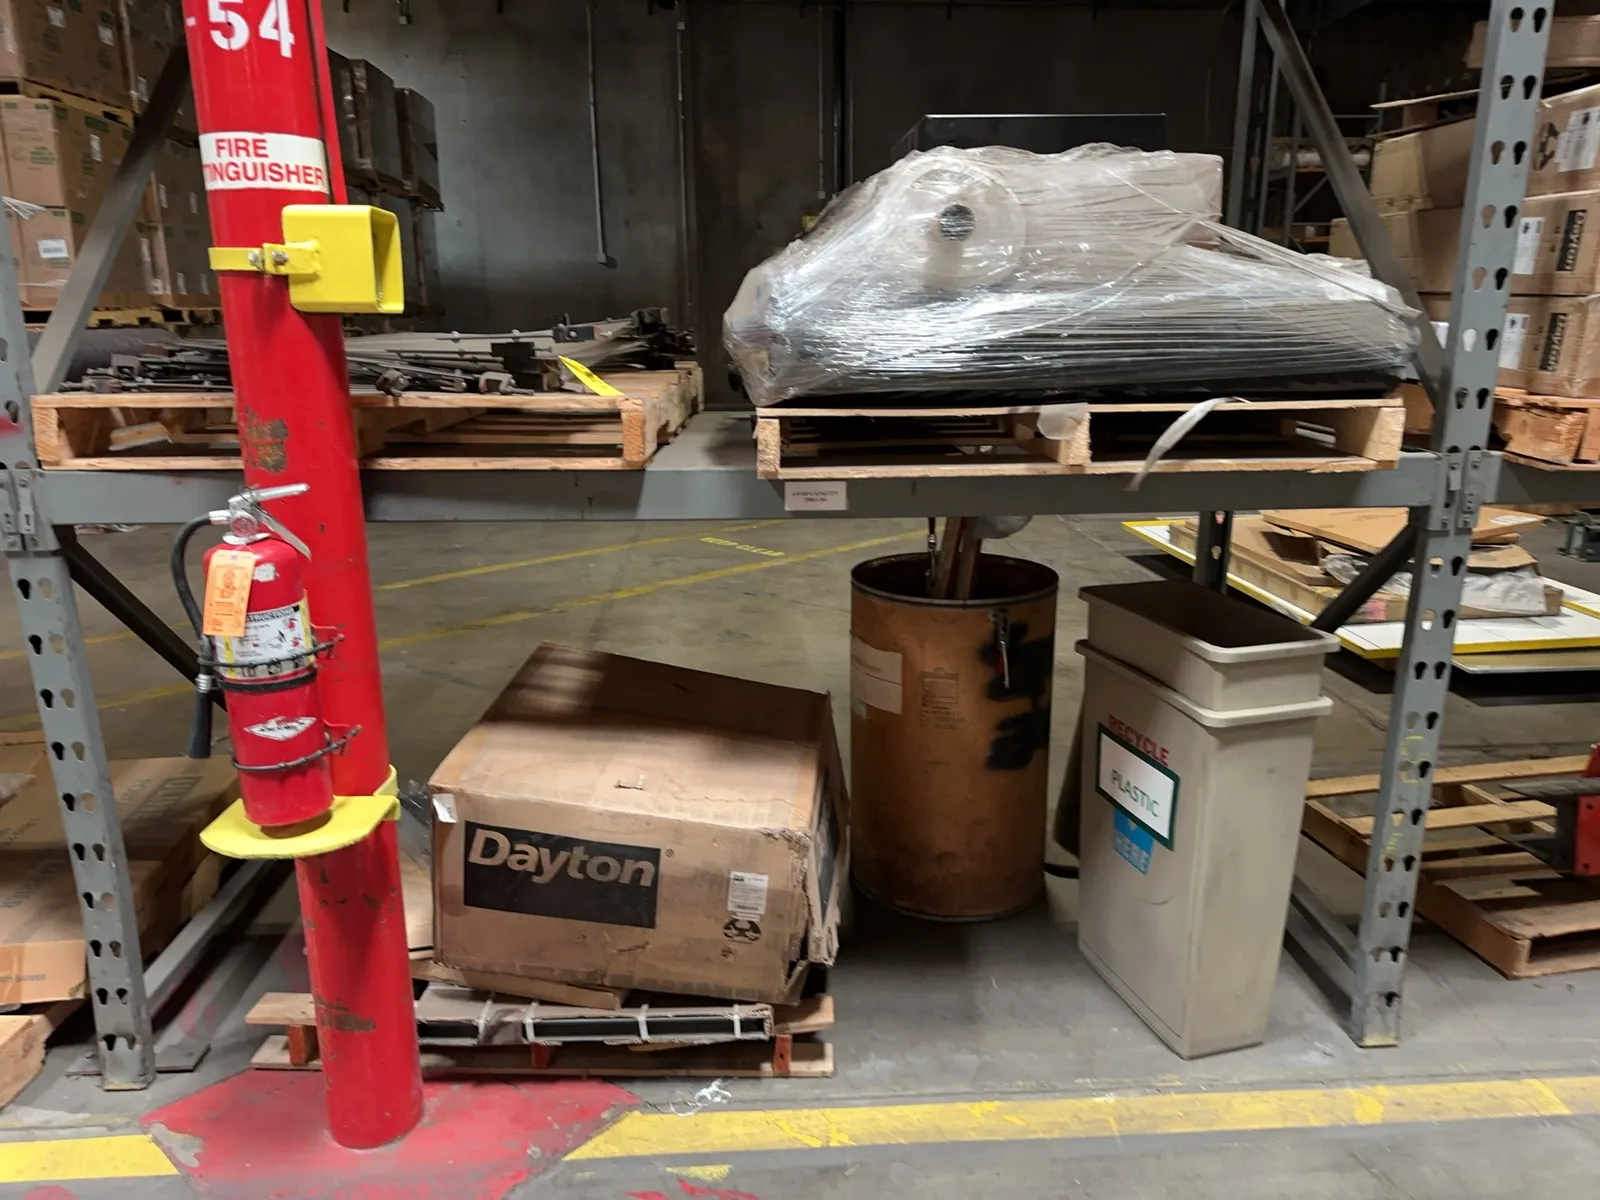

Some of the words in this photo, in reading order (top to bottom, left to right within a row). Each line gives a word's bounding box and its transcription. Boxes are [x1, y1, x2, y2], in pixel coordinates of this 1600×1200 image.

[215, 138, 270, 158] FIRE
[1108, 714, 1170, 767] RECYCLE
[1111, 769, 1160, 818] PLASTIC
[467, 828, 655, 887] Dayton
